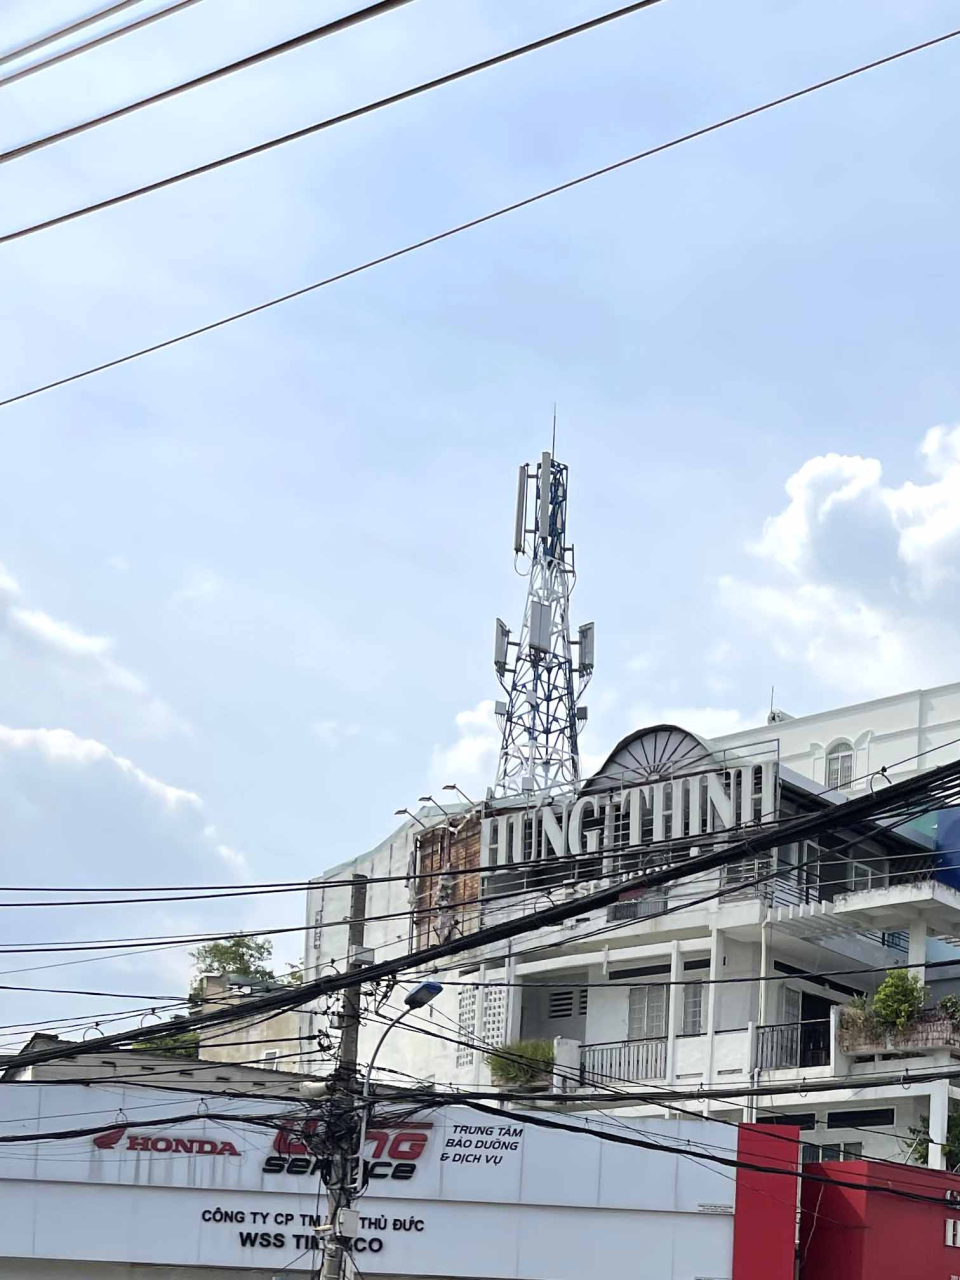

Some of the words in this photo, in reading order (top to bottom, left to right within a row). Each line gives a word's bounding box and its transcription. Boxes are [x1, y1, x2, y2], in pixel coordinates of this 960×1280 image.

[126, 1135, 242, 1156] HONDA
[452, 1125, 494, 1136] TRUNG
[498, 1126, 523, 1137] TÂM
[445, 1136, 472, 1149] BẢO
[474, 1139, 520, 1151] DƯỠNG
[440, 1152, 450, 1161] &
[452, 1154, 482, 1164] DỊCH
[485, 1154, 503, 1166] VỤ
[201, 1207, 245, 1223] CÔNG
[249, 1212, 269, 1225] TY
[274, 1213, 294, 1225] CP
[359, 1214, 387, 1231] THỦ
[392, 1215, 425, 1232] ĐỨC
[239, 1231, 285, 1249] WSS
